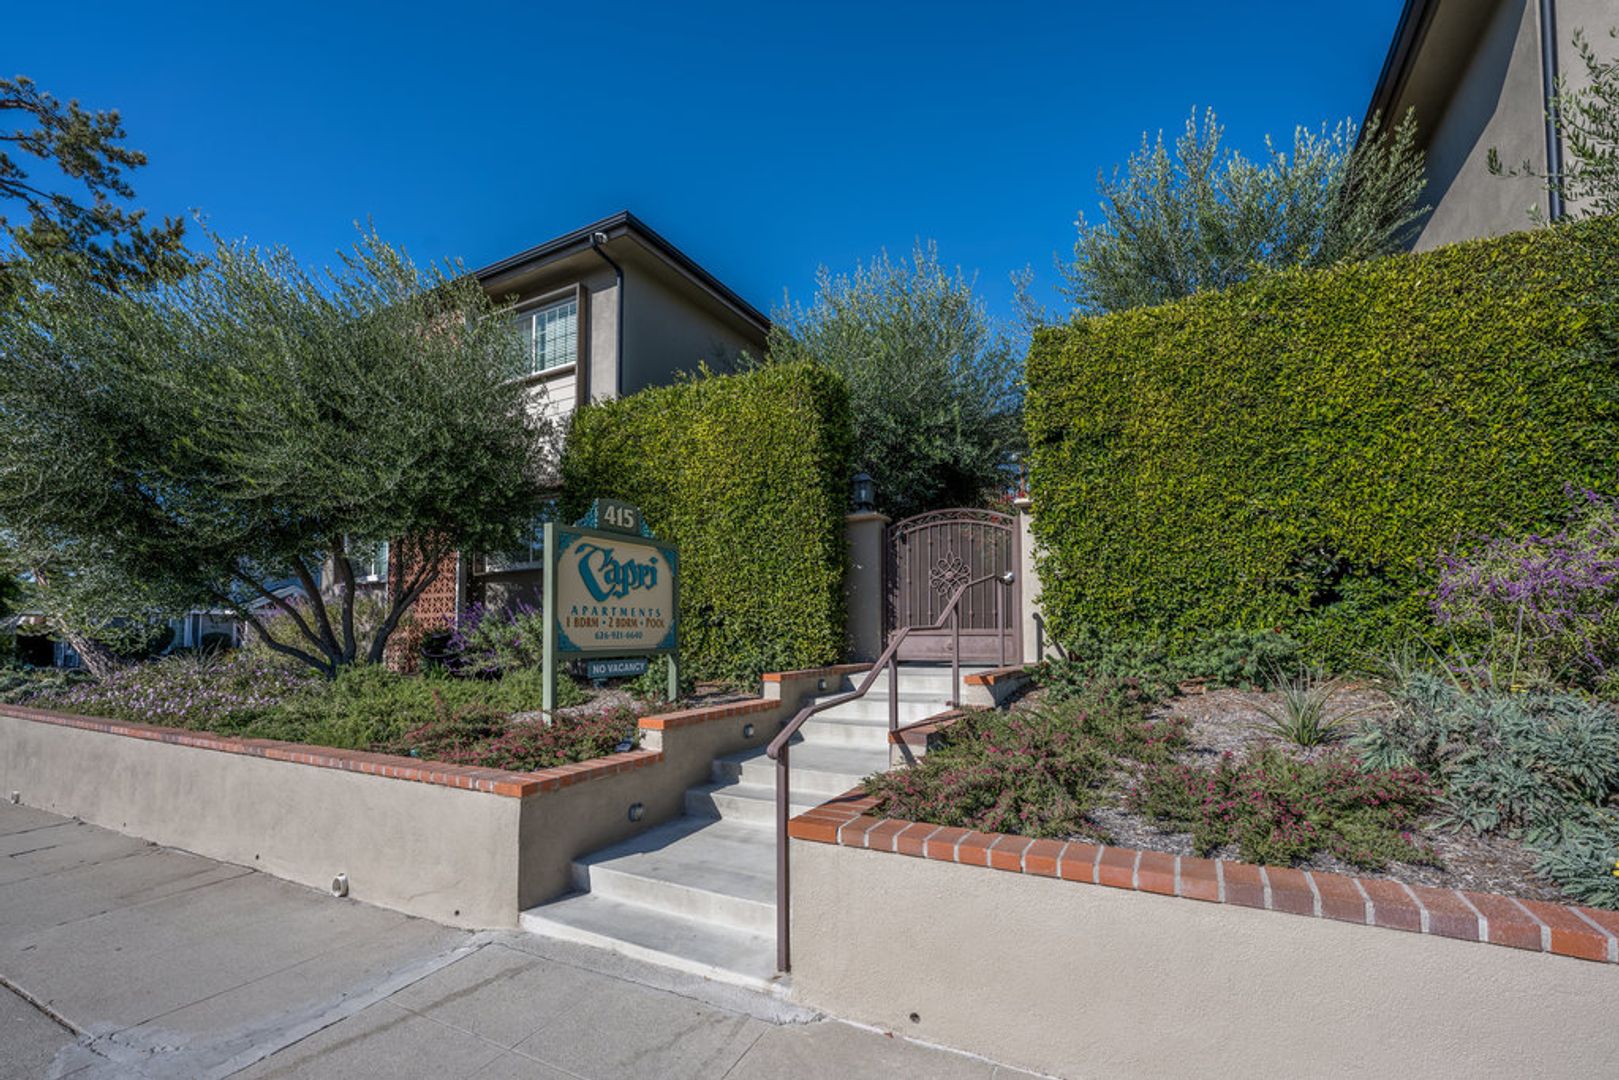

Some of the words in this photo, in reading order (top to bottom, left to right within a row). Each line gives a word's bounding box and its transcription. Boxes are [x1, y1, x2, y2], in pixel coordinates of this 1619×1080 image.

[603, 505, 635, 528] 415
[575, 543, 658, 602] Capri
[571, 606, 661, 617] APARTMENTS
[574, 617, 599, 628] BDRM
[608, 617, 613, 628] 2
[616, 617, 637, 628] BDRM
[645, 617, 665, 628] POOL
[592, 664, 606, 674] NO
[607, 662, 646, 673] VACANCY
